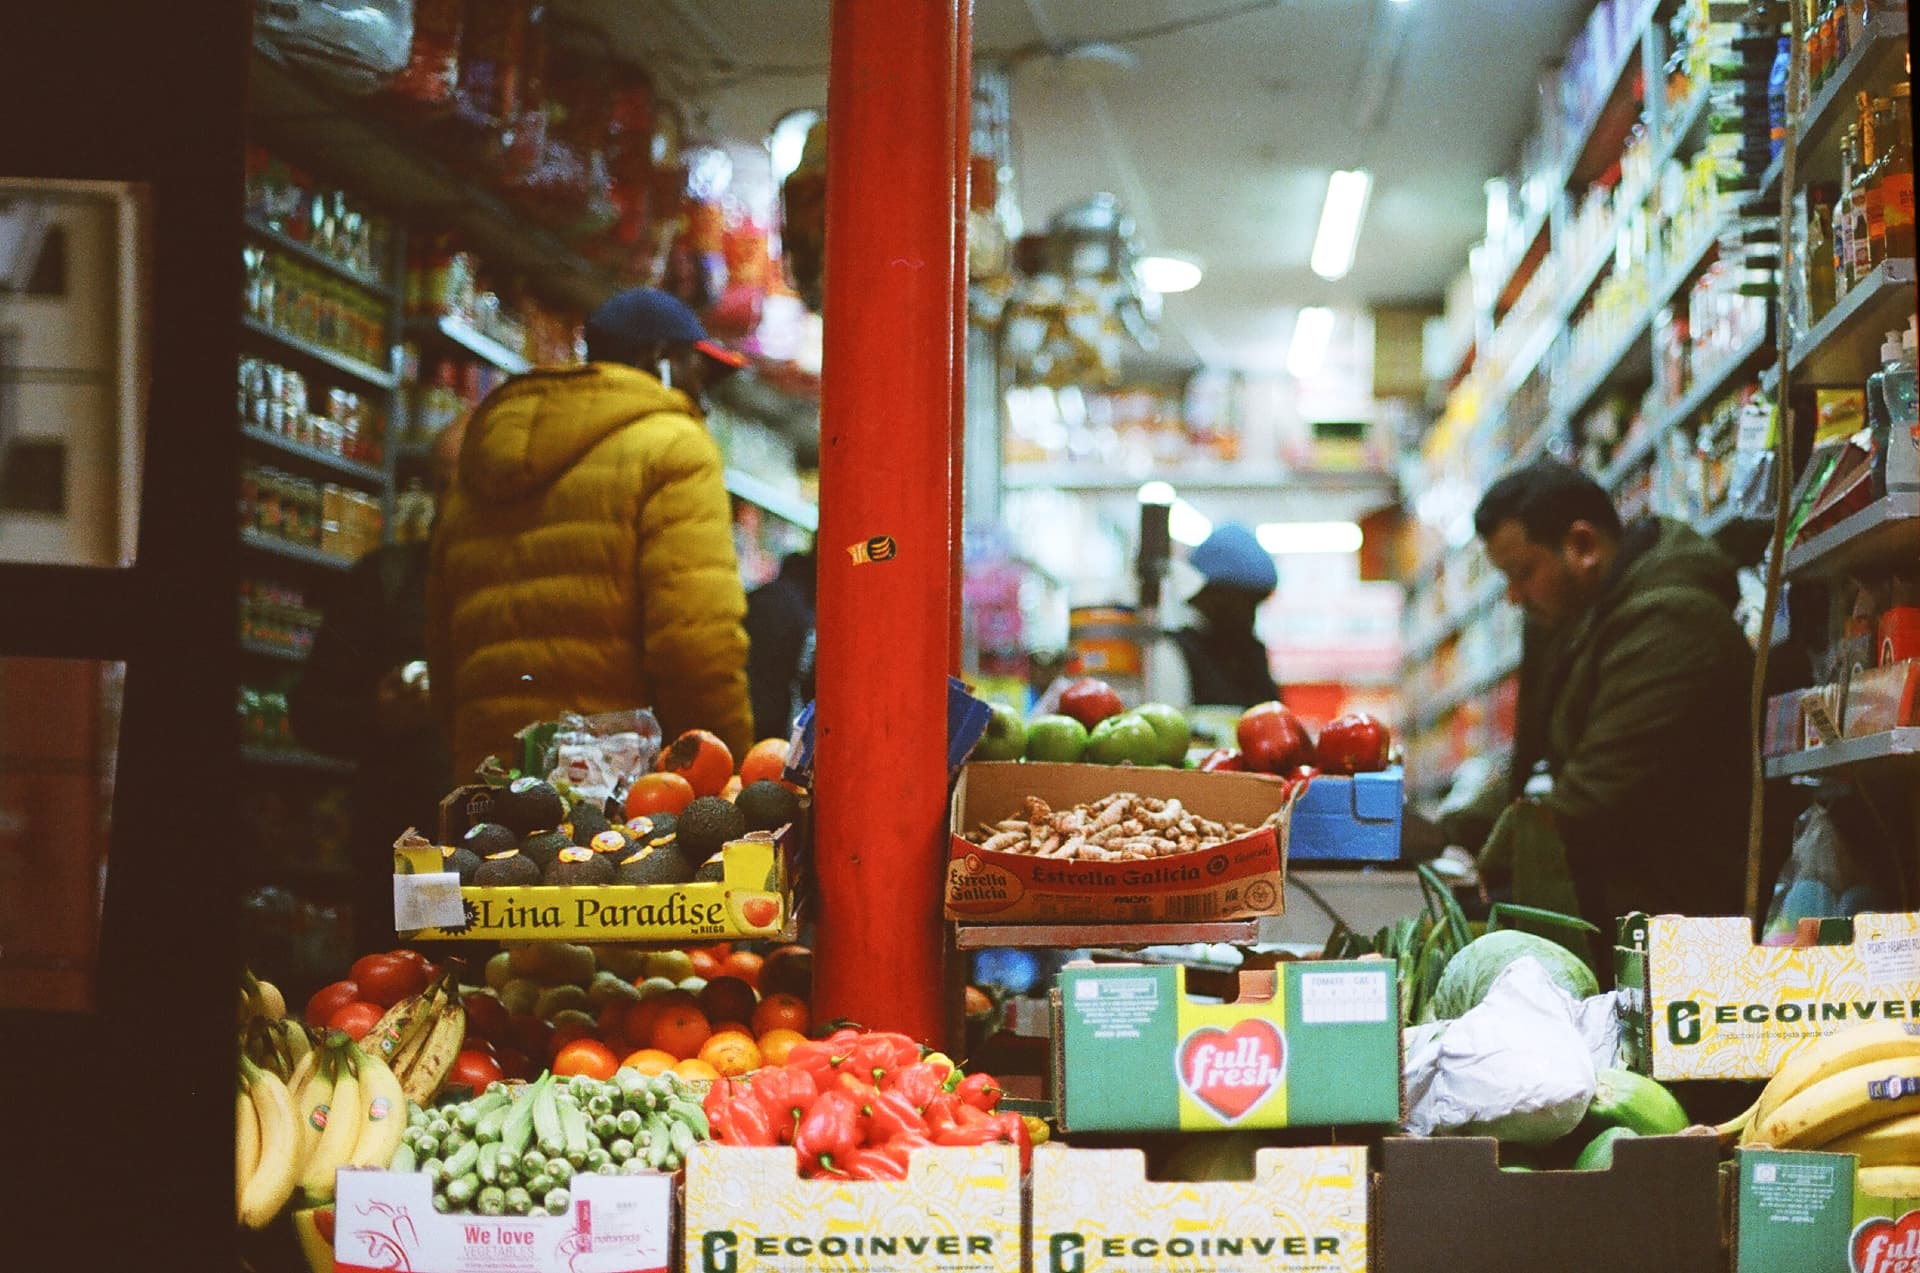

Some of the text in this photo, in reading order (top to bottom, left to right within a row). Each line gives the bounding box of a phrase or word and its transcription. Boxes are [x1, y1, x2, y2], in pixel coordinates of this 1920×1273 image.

[951, 868, 1008, 886] Estrella
[1032, 864, 1118, 887] Estrella
[1121, 862, 1201, 886] Galicia
[950, 885, 1008, 900] Galicia
[482, 892, 725, 928] Lina Paradise
[1193, 1037, 1260, 1071] full
[1191, 1055, 1278, 1090] fresh
[464, 1225, 534, 1245] We love
[755, 1236, 993, 1257] ECOINVER
[1102, 1237, 1340, 1258] ECOINVER
